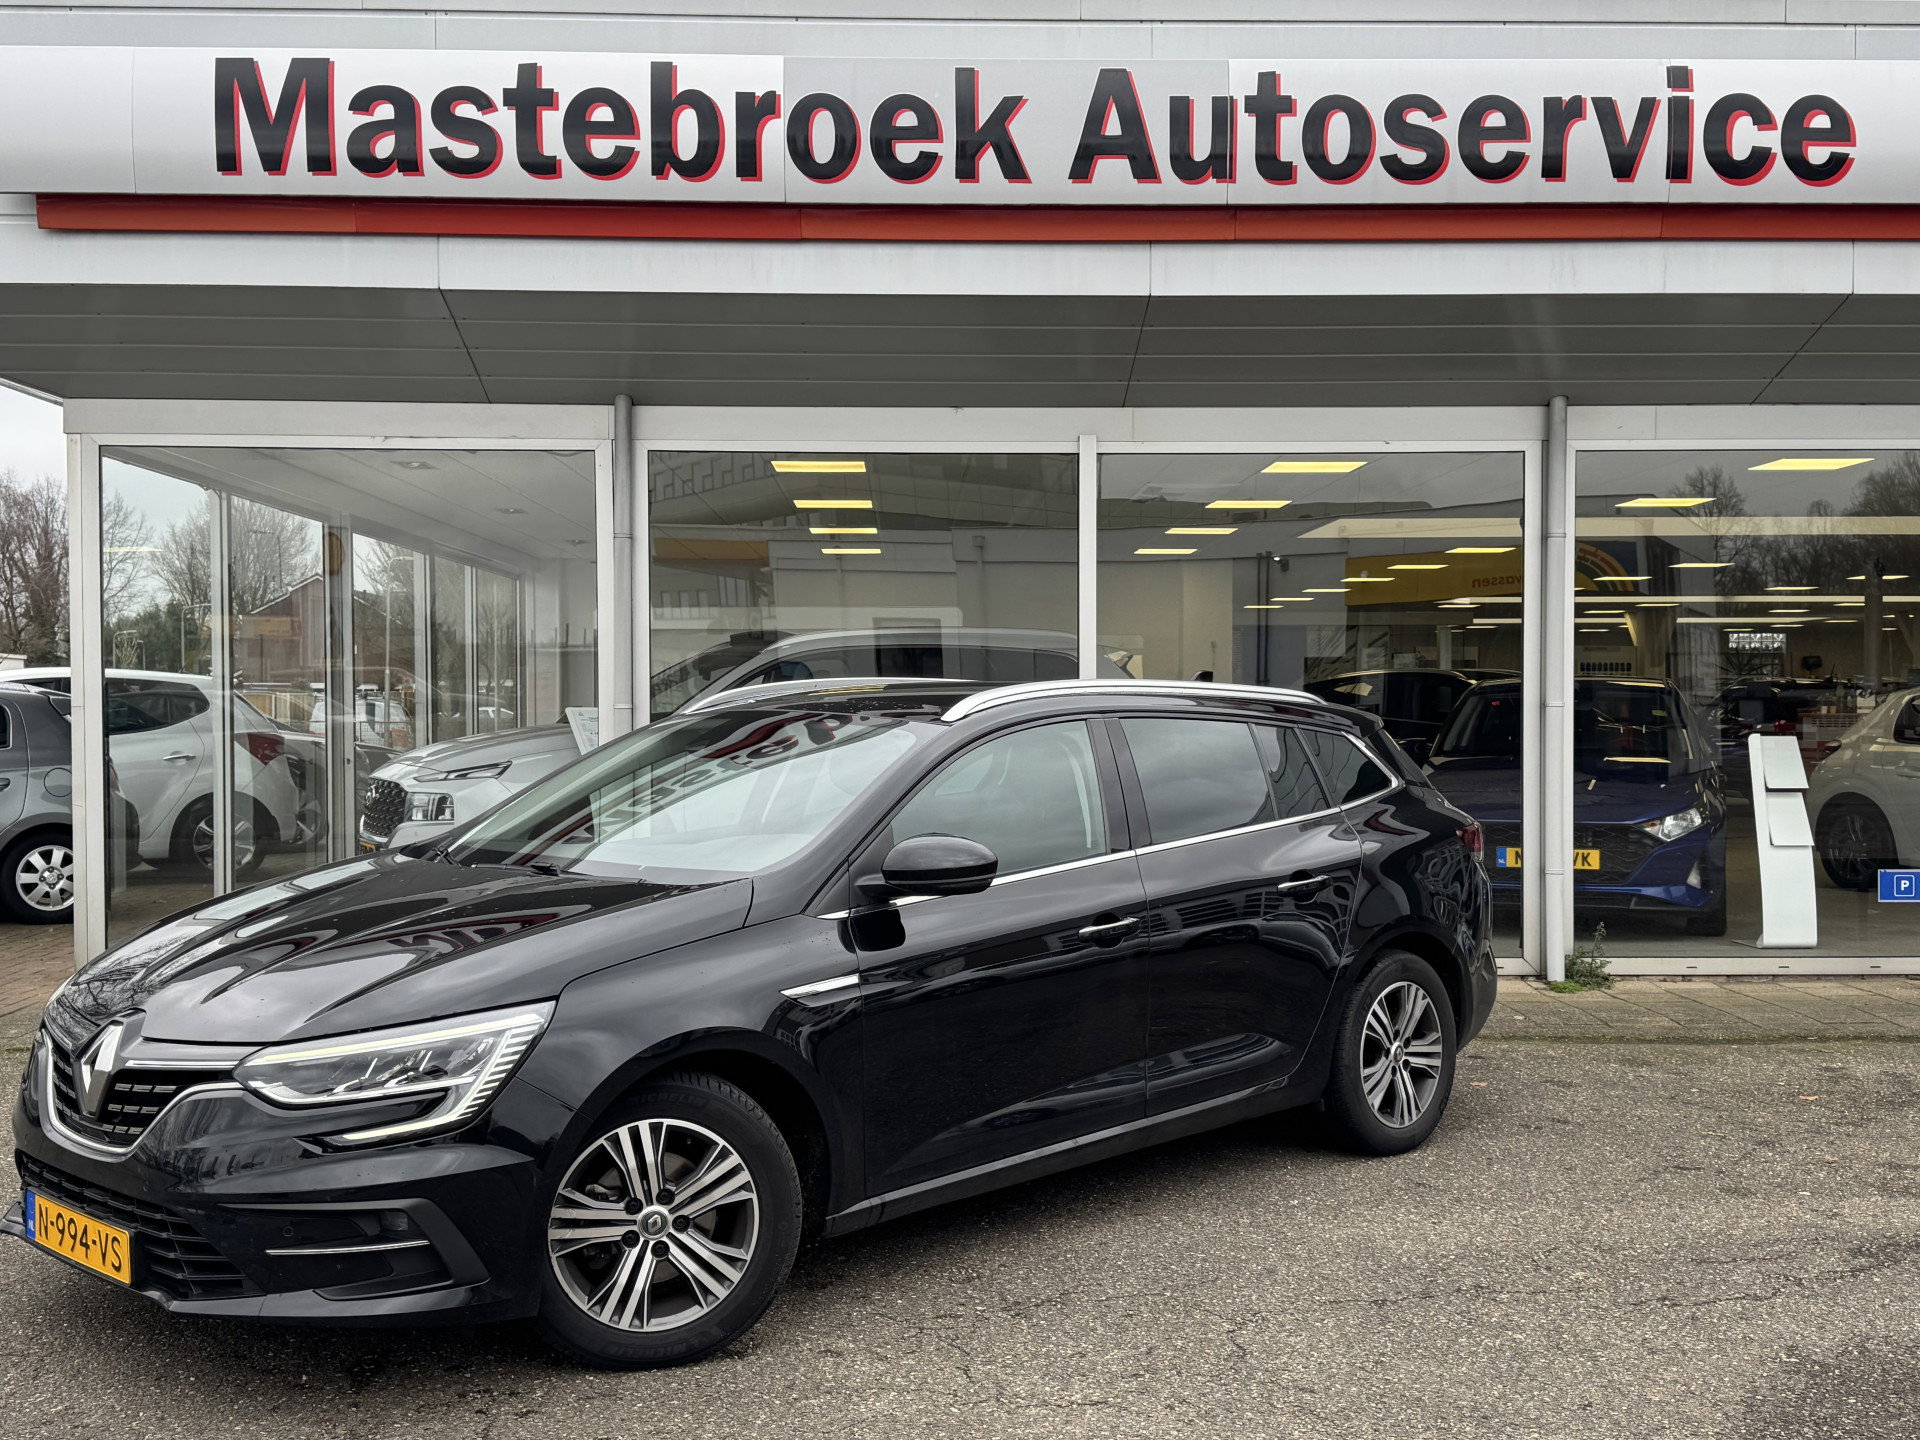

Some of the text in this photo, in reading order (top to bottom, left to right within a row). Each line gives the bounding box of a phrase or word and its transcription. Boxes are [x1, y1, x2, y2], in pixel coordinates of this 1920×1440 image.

[214, 56, 1857, 187] Mastebroek Autoservice
[1901, 880, 1910, 891] P
[38, 1202, 122, 1273] N-994-VS
